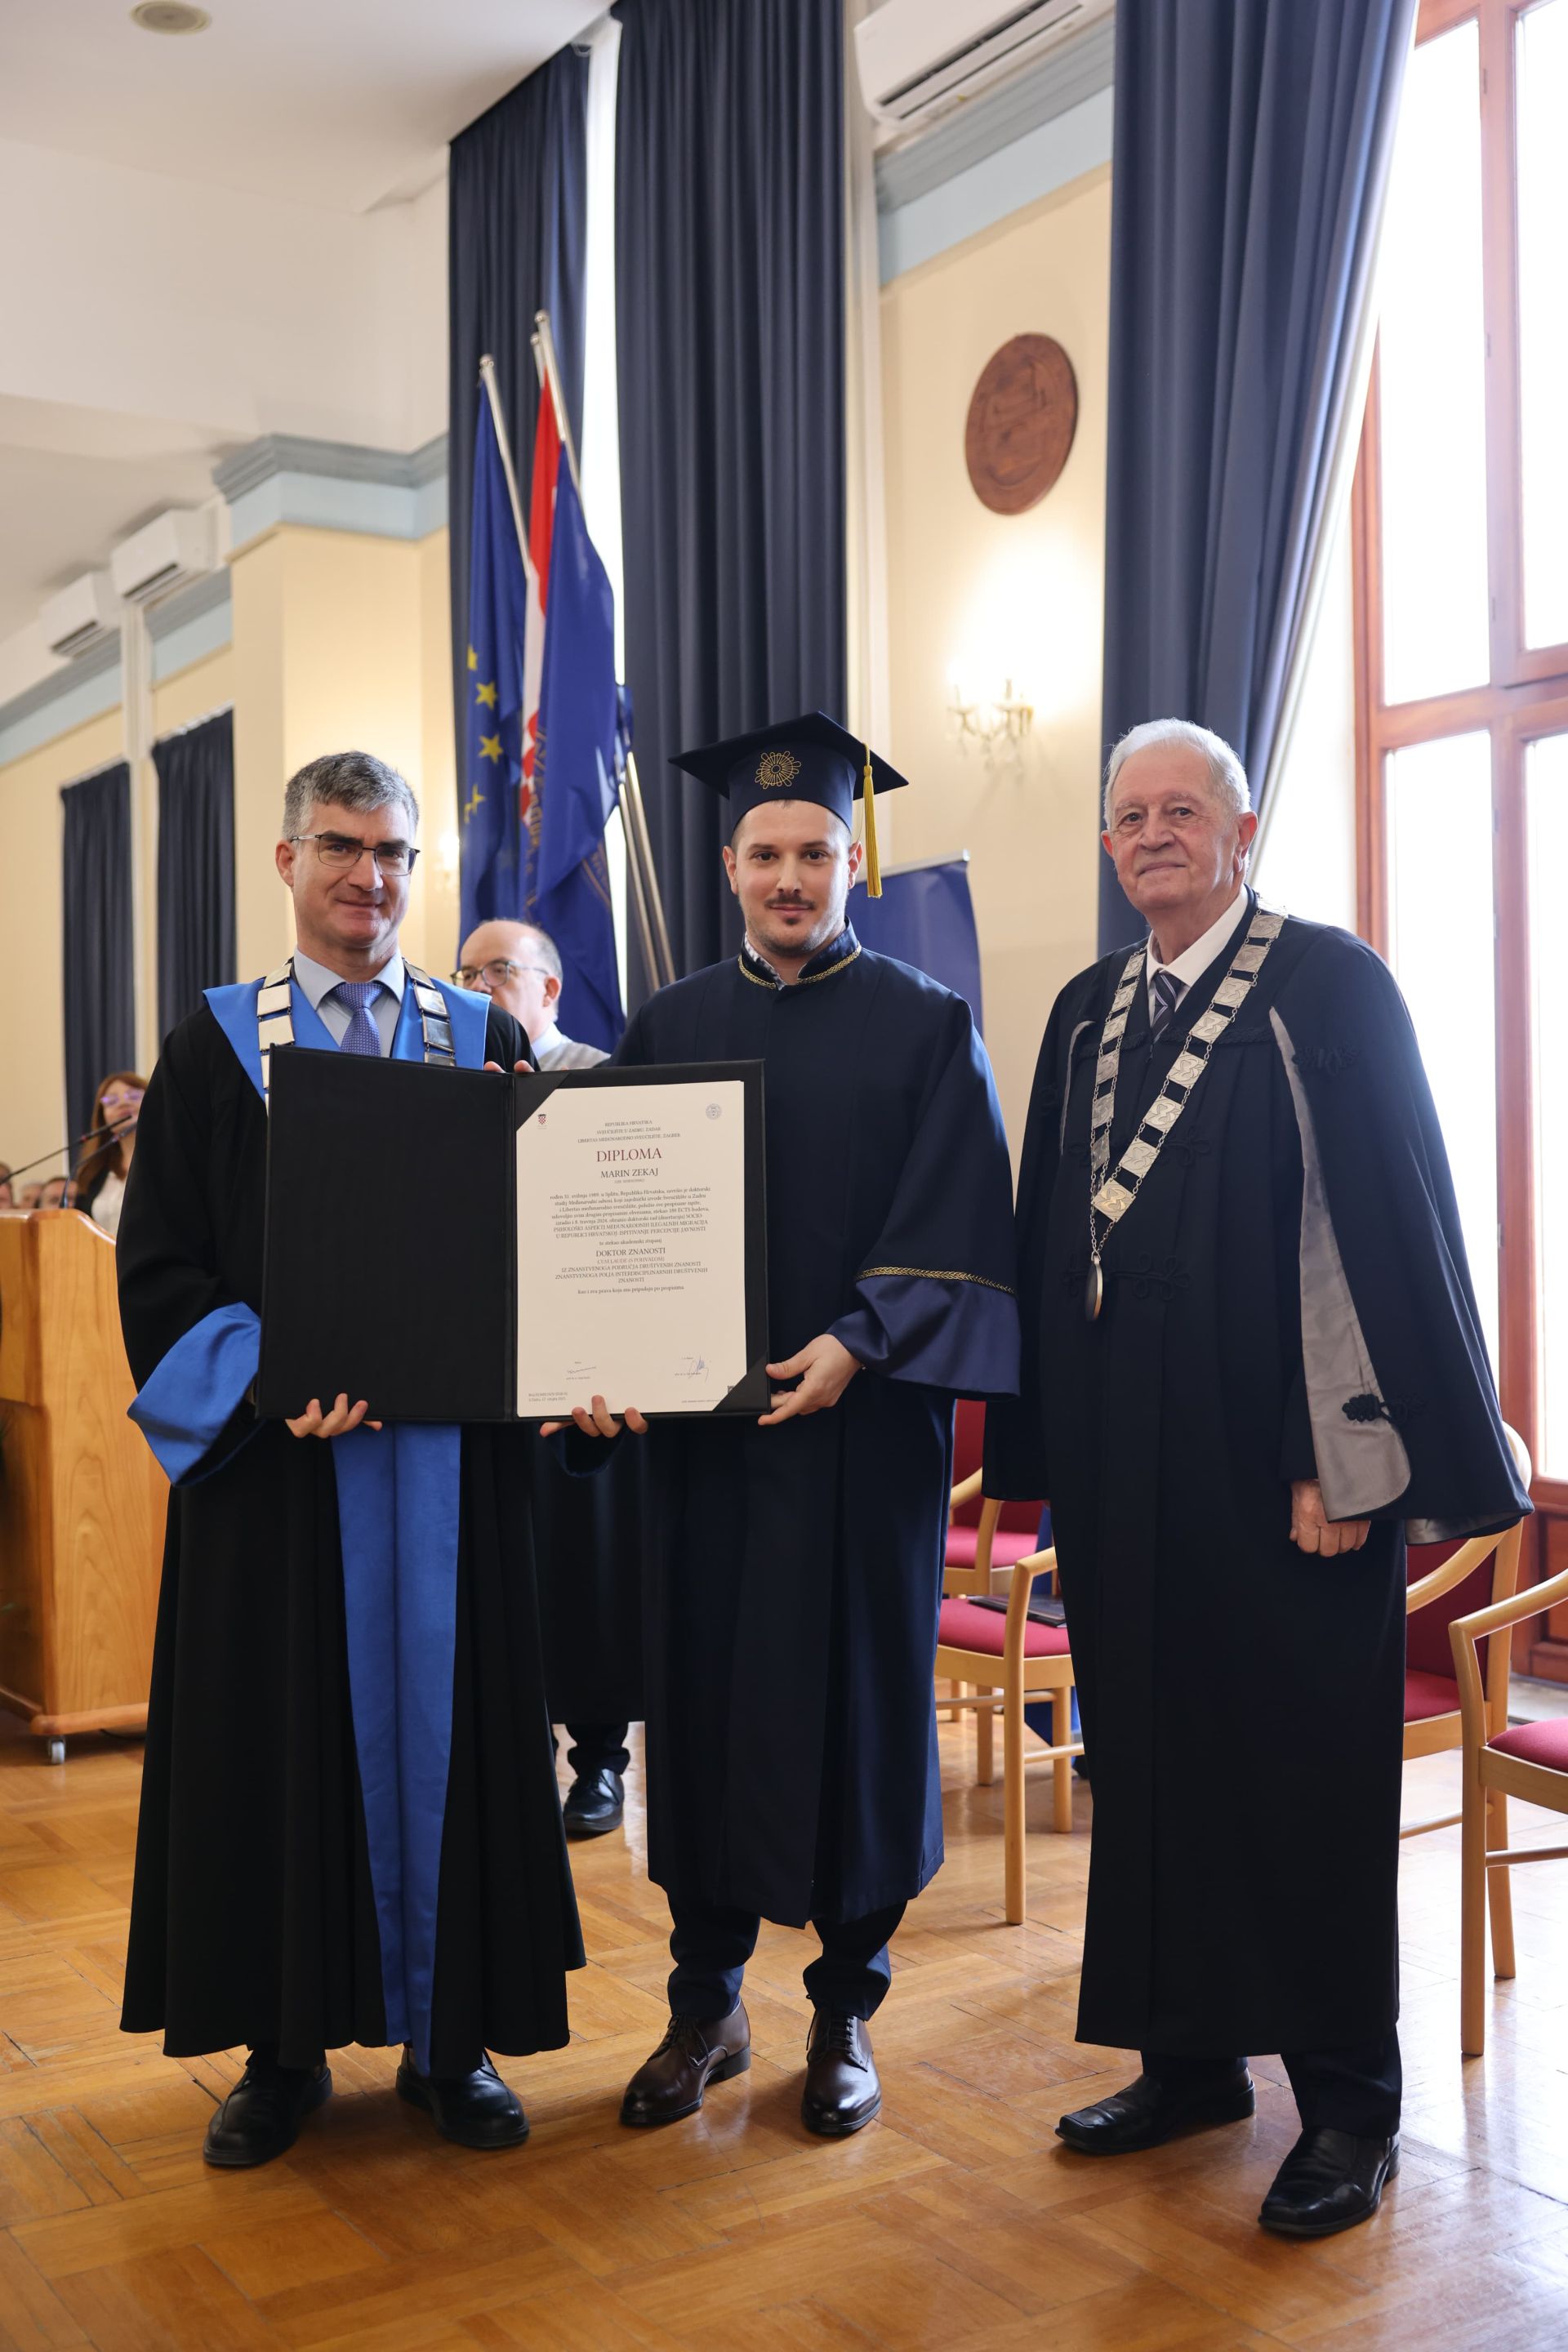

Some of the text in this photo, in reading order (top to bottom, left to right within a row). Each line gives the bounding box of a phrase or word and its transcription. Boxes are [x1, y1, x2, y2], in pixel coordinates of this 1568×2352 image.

[596, 1148, 662, 1162] DIPLOMA
[601, 1168, 658, 1178] MARIN ZEKAJ
